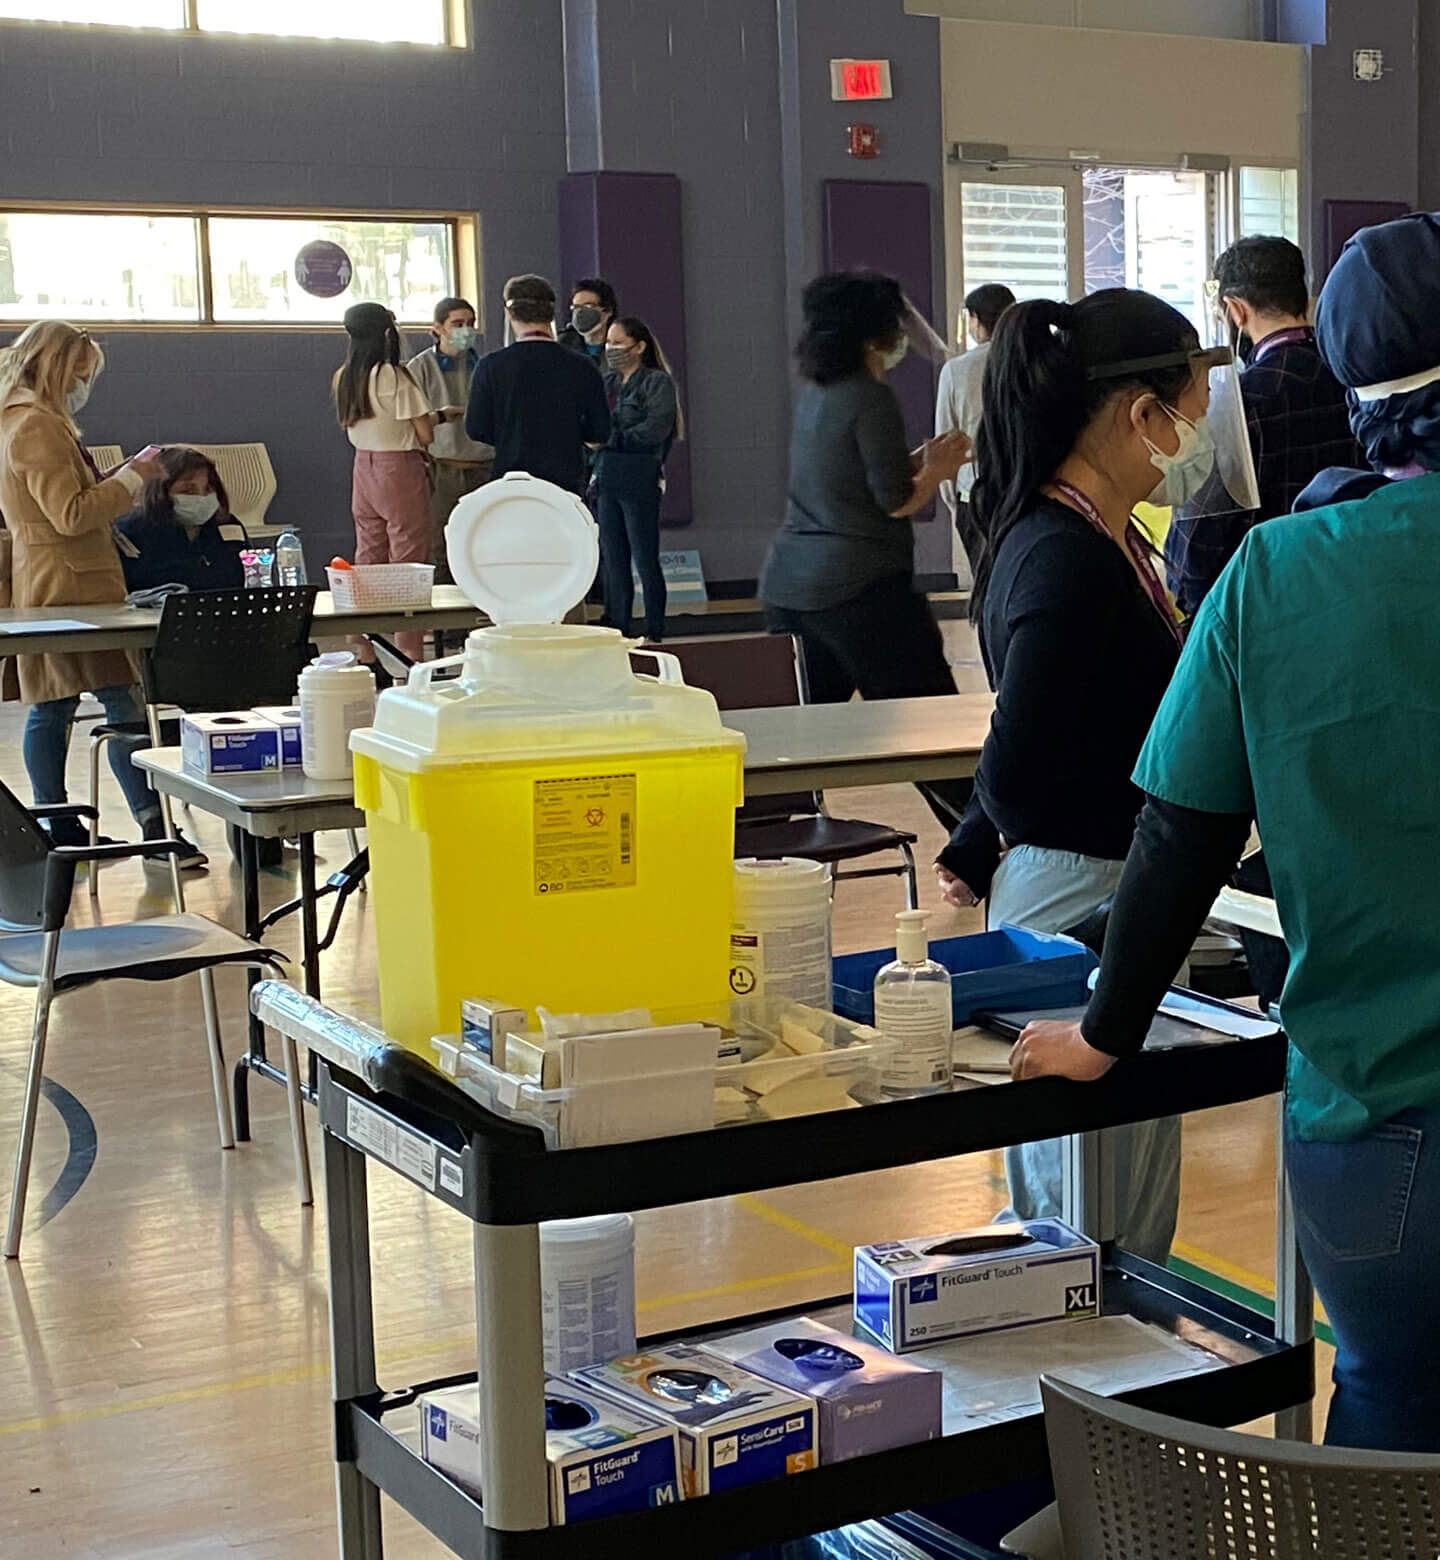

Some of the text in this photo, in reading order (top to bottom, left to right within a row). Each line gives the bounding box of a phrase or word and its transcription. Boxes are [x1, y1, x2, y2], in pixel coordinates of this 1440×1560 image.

[843, 63, 881, 98] EXIT
[264, 755, 277, 766] M
[874, 1253, 915, 1264] XL
[942, 1265, 1024, 1288] FitGuard Touch
[1068, 1286, 1097, 1310] XL
[593, 1450, 640, 1475] FitGuard
[795, 1454, 807, 1473] S
[594, 1469, 625, 1487] Touch
[655, 1484, 674, 1507] M
